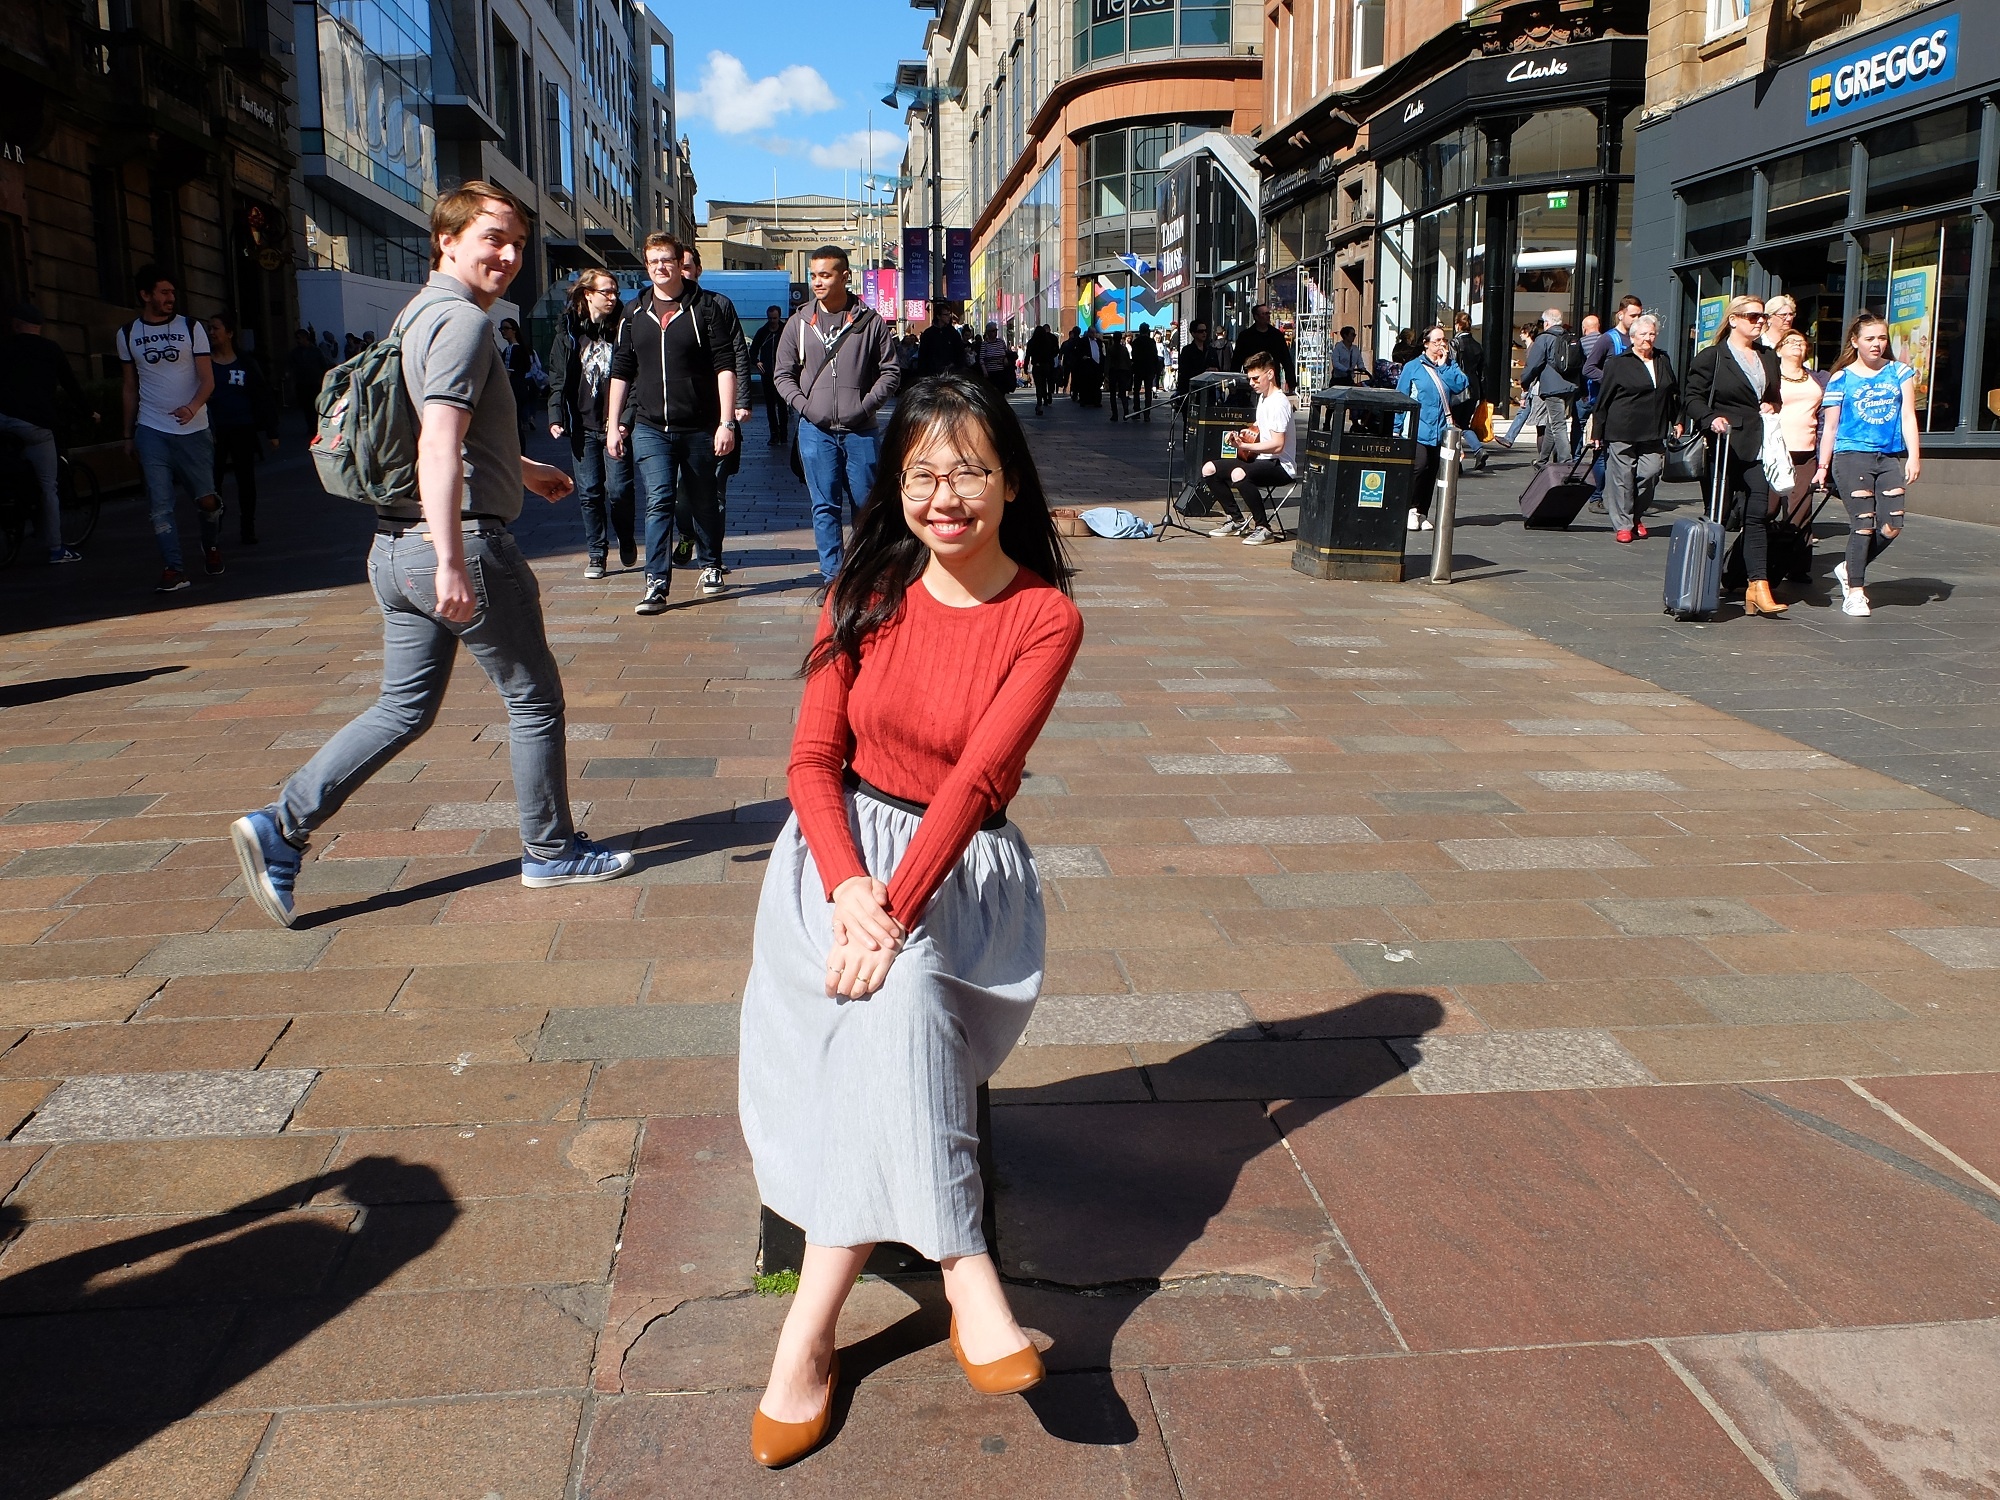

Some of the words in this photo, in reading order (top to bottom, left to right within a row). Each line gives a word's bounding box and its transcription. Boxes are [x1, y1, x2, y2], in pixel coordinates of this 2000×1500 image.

[1506, 58, 1568, 83] Clarks
[1834, 29, 1948, 101] GREGGS
[1403, 100, 1424, 123] Clarks
[1161, 215, 1185, 249] TARTAN
[1162, 247, 1183, 277] HOUSE
[135, 333, 185, 346] BROWSE
[228, 369, 246, 386] H
[1853, 396, 1896, 412] Carnival
[1361, 445, 1391, 453] LITTER
